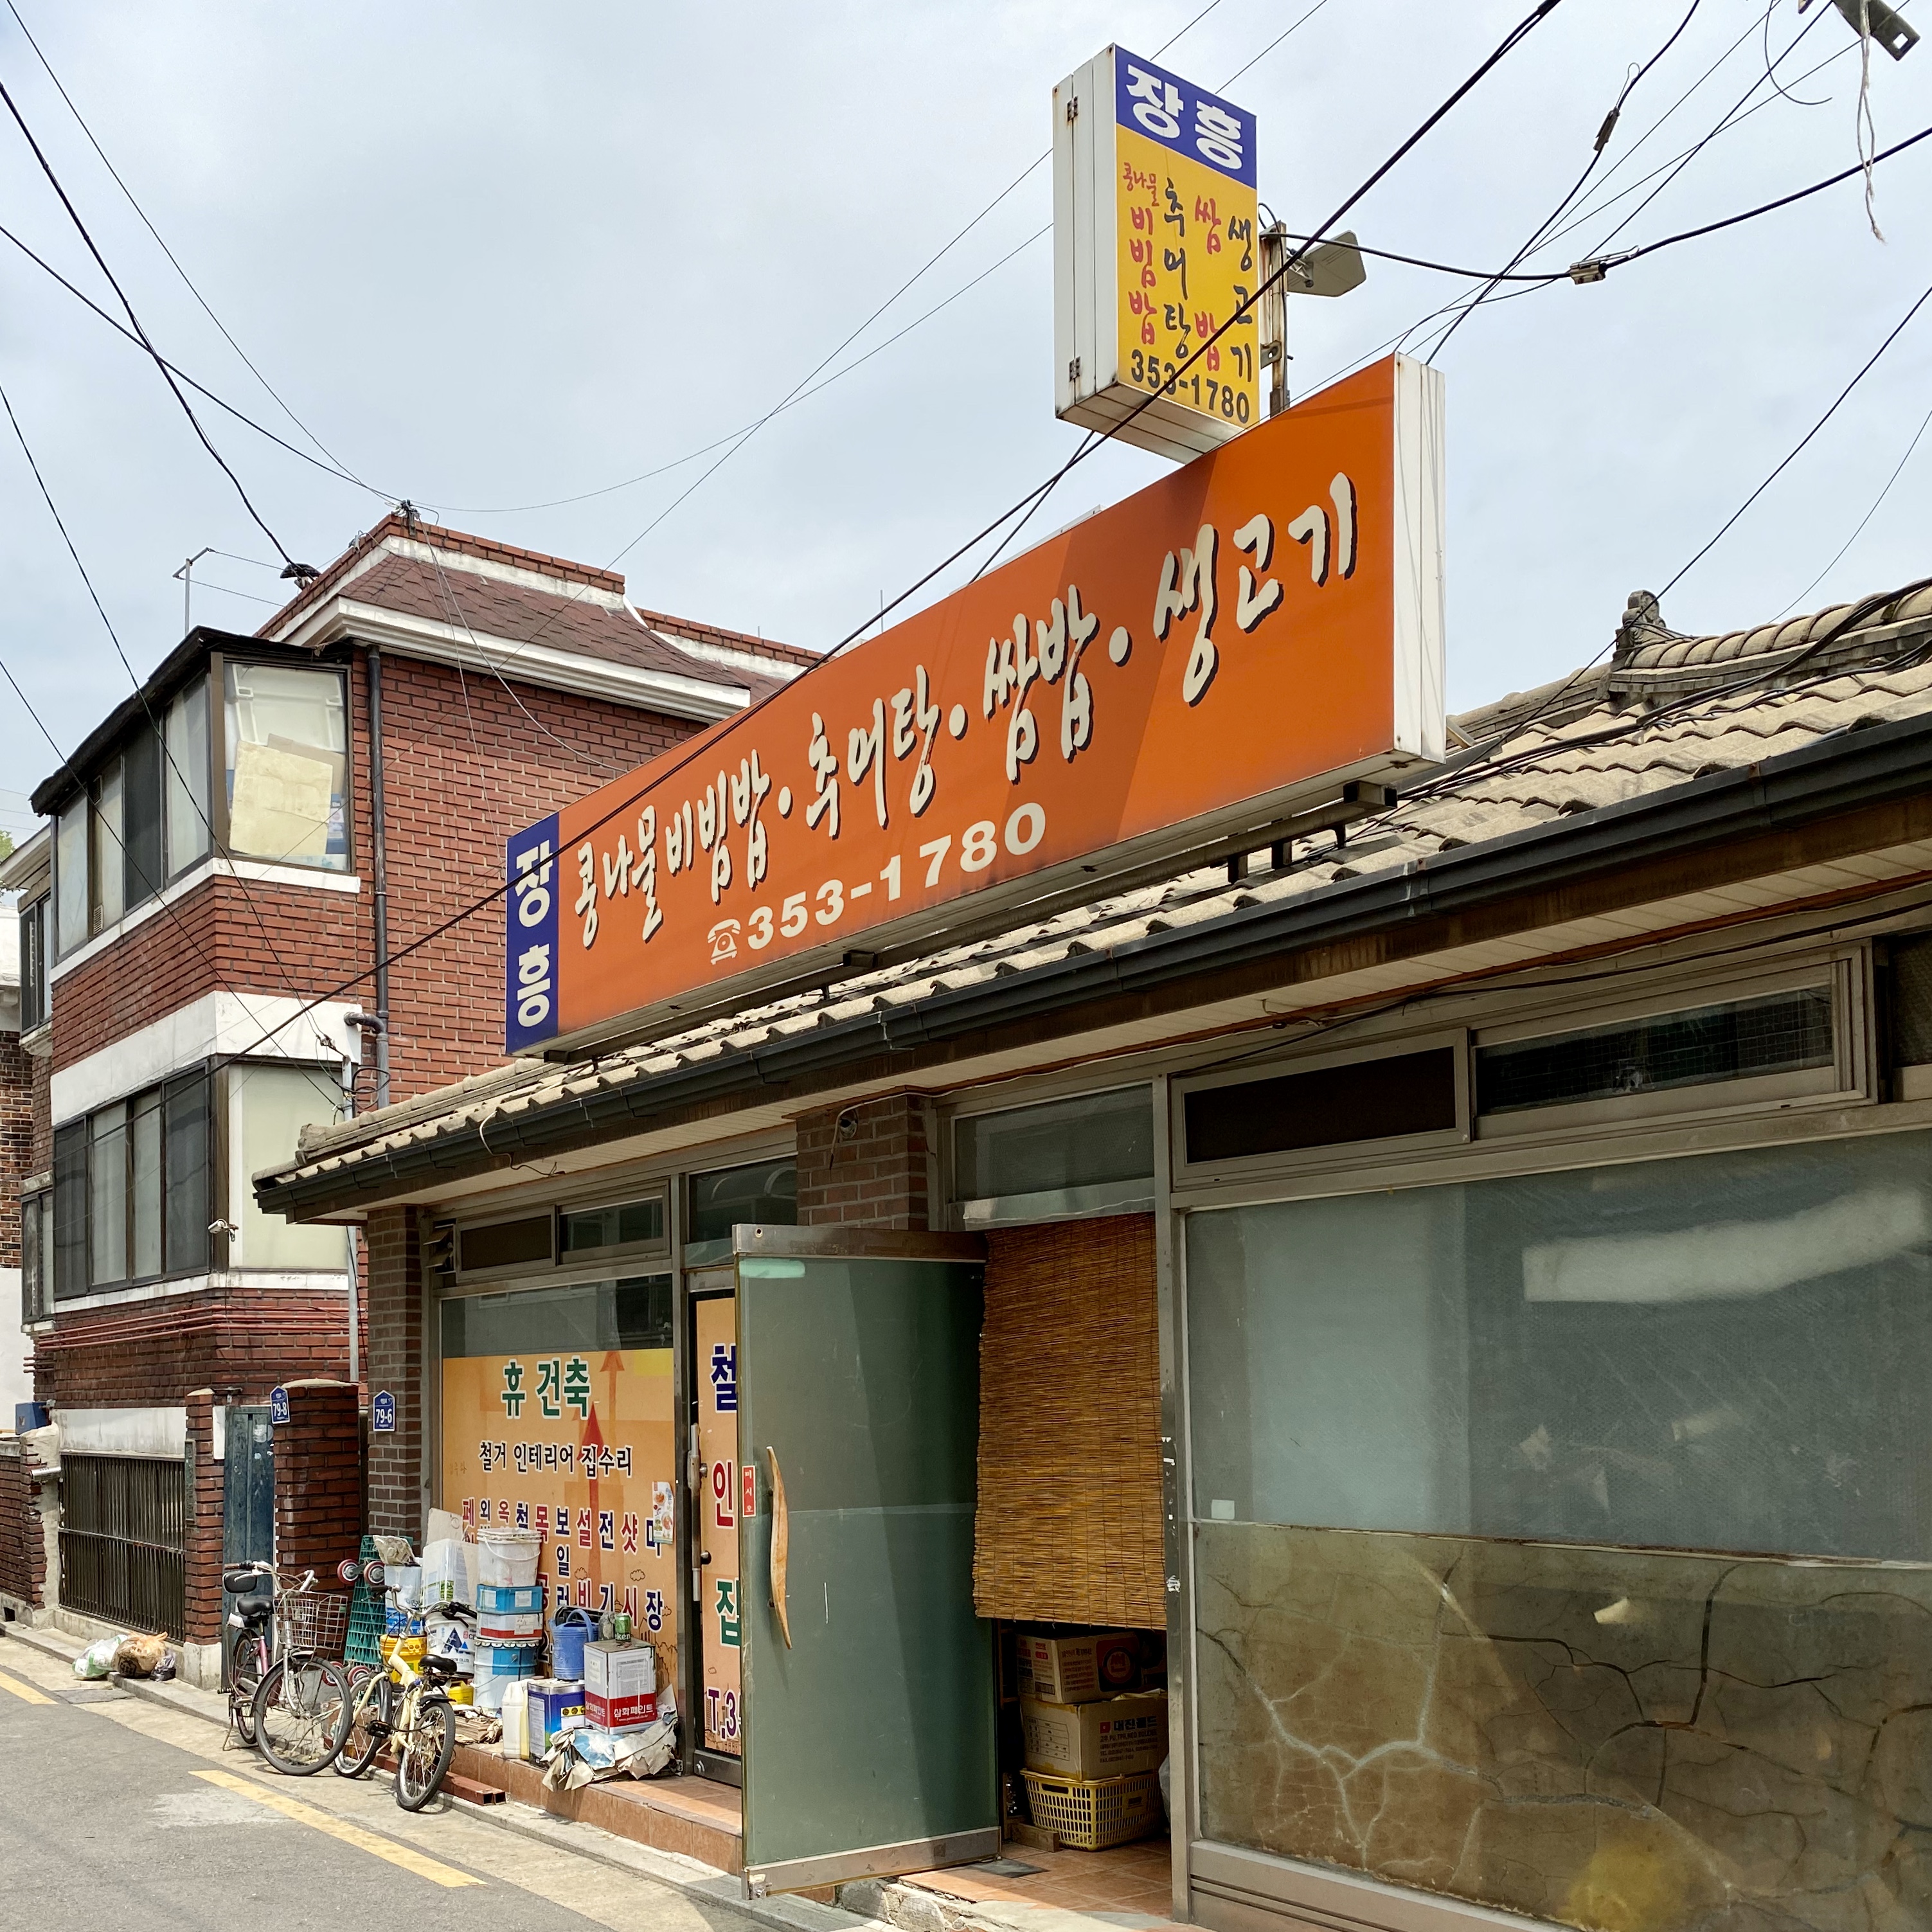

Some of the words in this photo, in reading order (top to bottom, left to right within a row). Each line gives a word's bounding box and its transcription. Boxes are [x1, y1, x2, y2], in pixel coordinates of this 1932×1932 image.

[1126, 62, 1244, 171] 장흥
[1122, 161, 1160, 208] 콩나물
[1127, 204, 1156, 345] 비빔밥
[1163, 176, 1192, 360] 추어탕
[1228, 215, 1253, 383] 생고기
[1130, 349, 1250, 424] 353-1780
[1152, 470, 1358, 708] 생고기
[747, 801, 1046, 951] 353-1780
[514, 839, 553, 1028] 장흥
[273, 1402, 287, 1417] 79-8
[375, 1408, 393, 1424] 79-6
[500, 1359, 527, 1418] 휴
[535, 1356, 592, 1419] 건축
[479, 1440, 508, 1473] 철거
[513, 1442, 575, 1475] 인테리어
[580, 1444, 634, 1479] 집수리
[744, 1469, 754, 1513] 미시오
[613, 1703, 654, 1718] 삼화페인트
